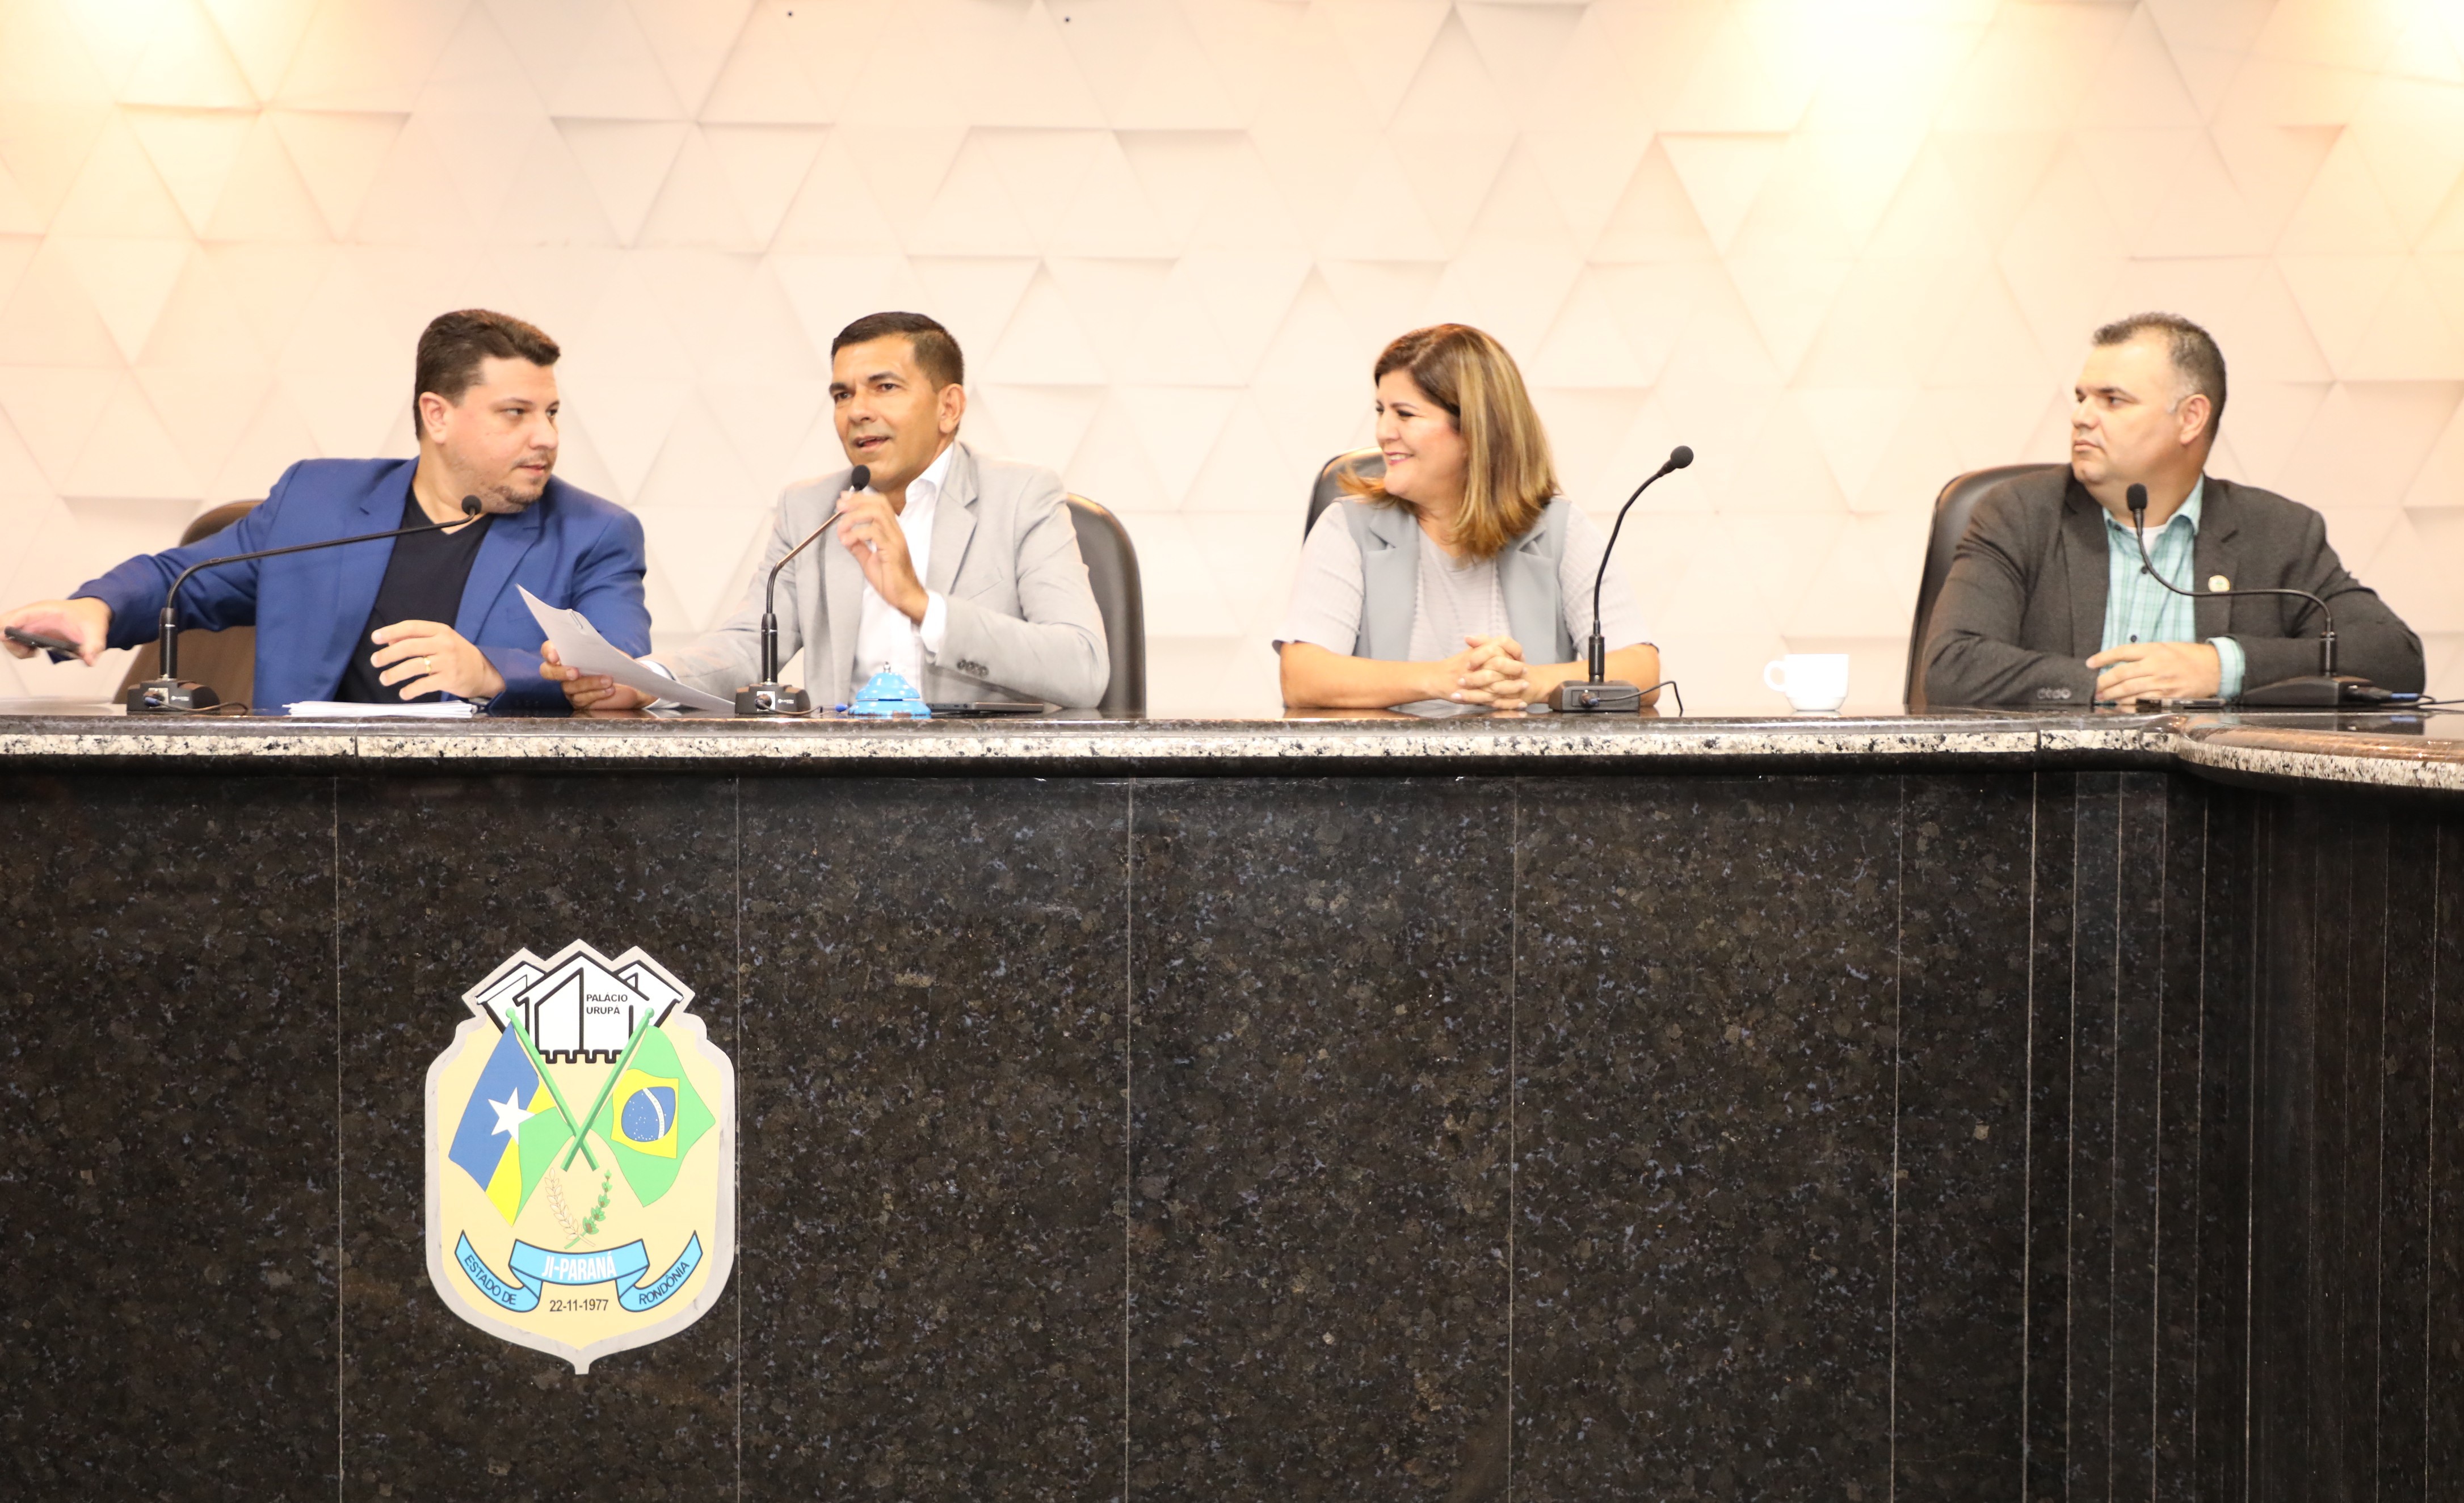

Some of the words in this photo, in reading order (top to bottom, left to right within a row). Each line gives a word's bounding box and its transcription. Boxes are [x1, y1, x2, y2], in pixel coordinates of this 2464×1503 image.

[586, 992, 628, 1002] PALÁCIO
[586, 1005, 620, 1014] URUPÁ
[541, 1251, 617, 1281] JI-PARANÁ
[464, 1254, 501, 1296] ESTADO
[502, 1291, 516, 1305] DE
[639, 1261, 689, 1304] RONDÔNIA
[549, 1299, 608, 1312] 22-11-1977
